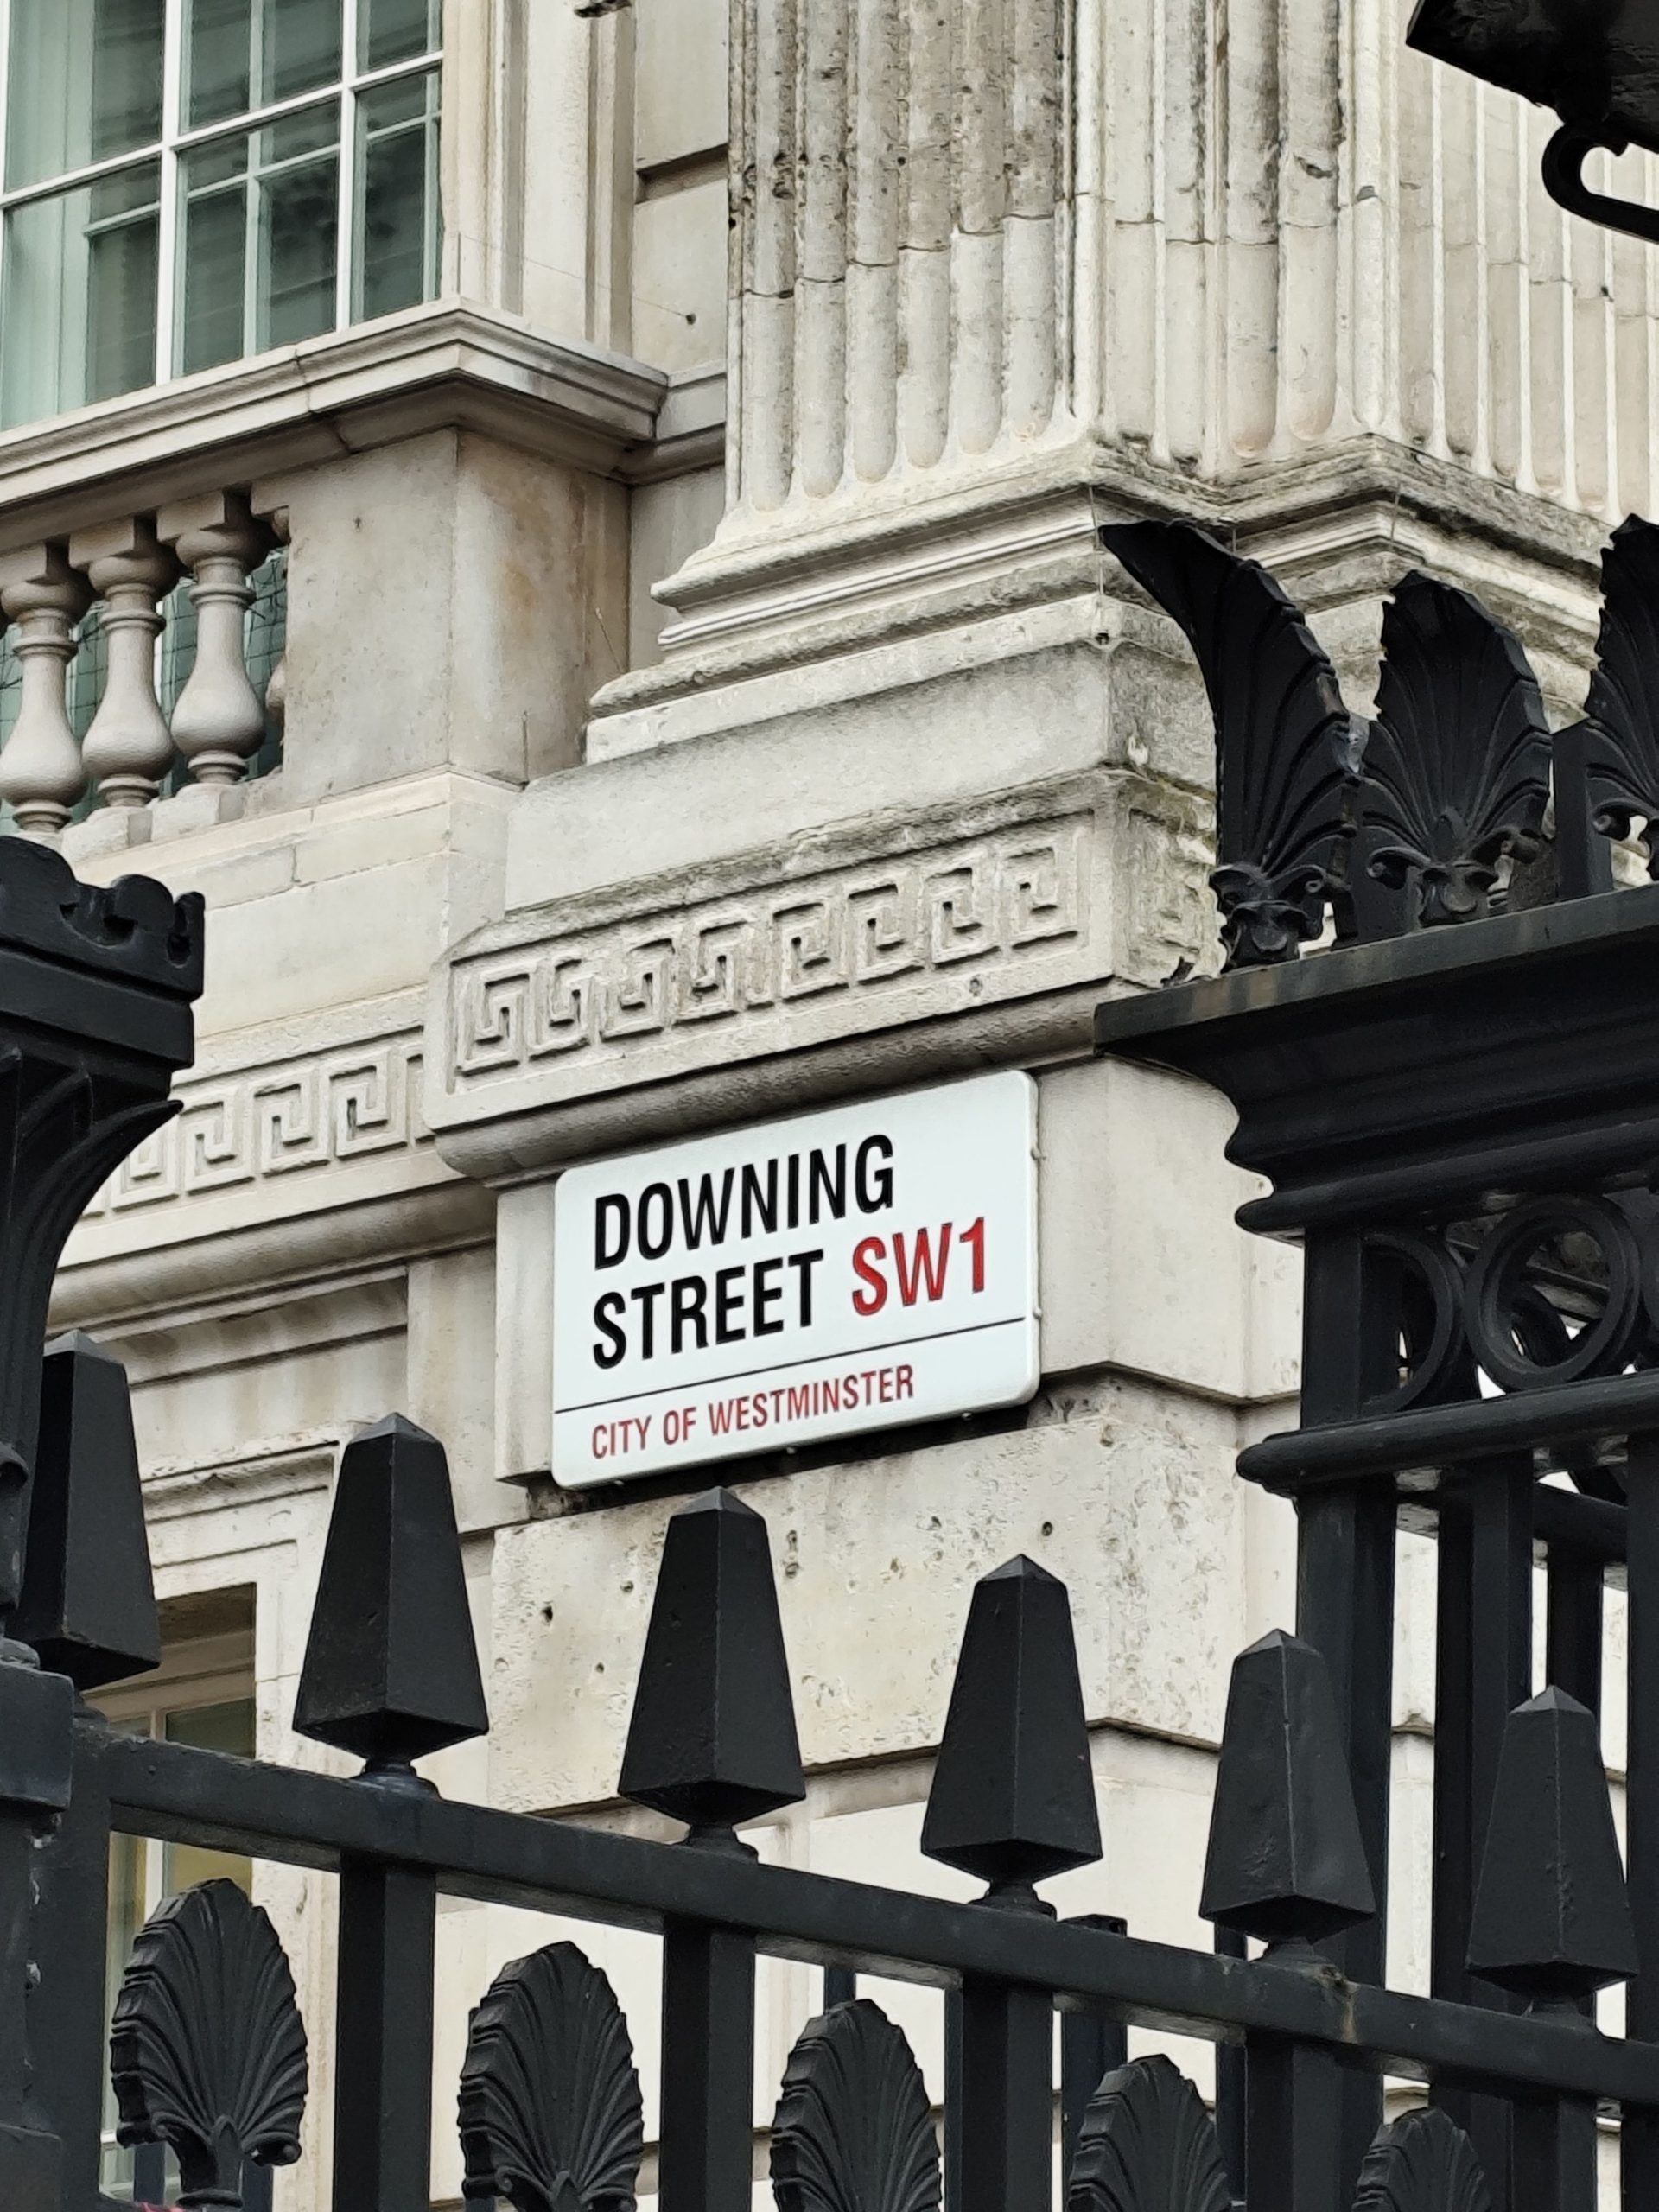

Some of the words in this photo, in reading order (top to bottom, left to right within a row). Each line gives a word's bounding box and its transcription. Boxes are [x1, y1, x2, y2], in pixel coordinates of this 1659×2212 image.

[594, 1134, 893, 1270] DOWNING
[593, 1249, 824, 1370] STREET
[852, 1217, 986, 1317] SW1
[592, 1416, 652, 1459] CITY
[663, 1407, 696, 1445] OF
[709, 1364, 914, 1435] WESTMINSTER
